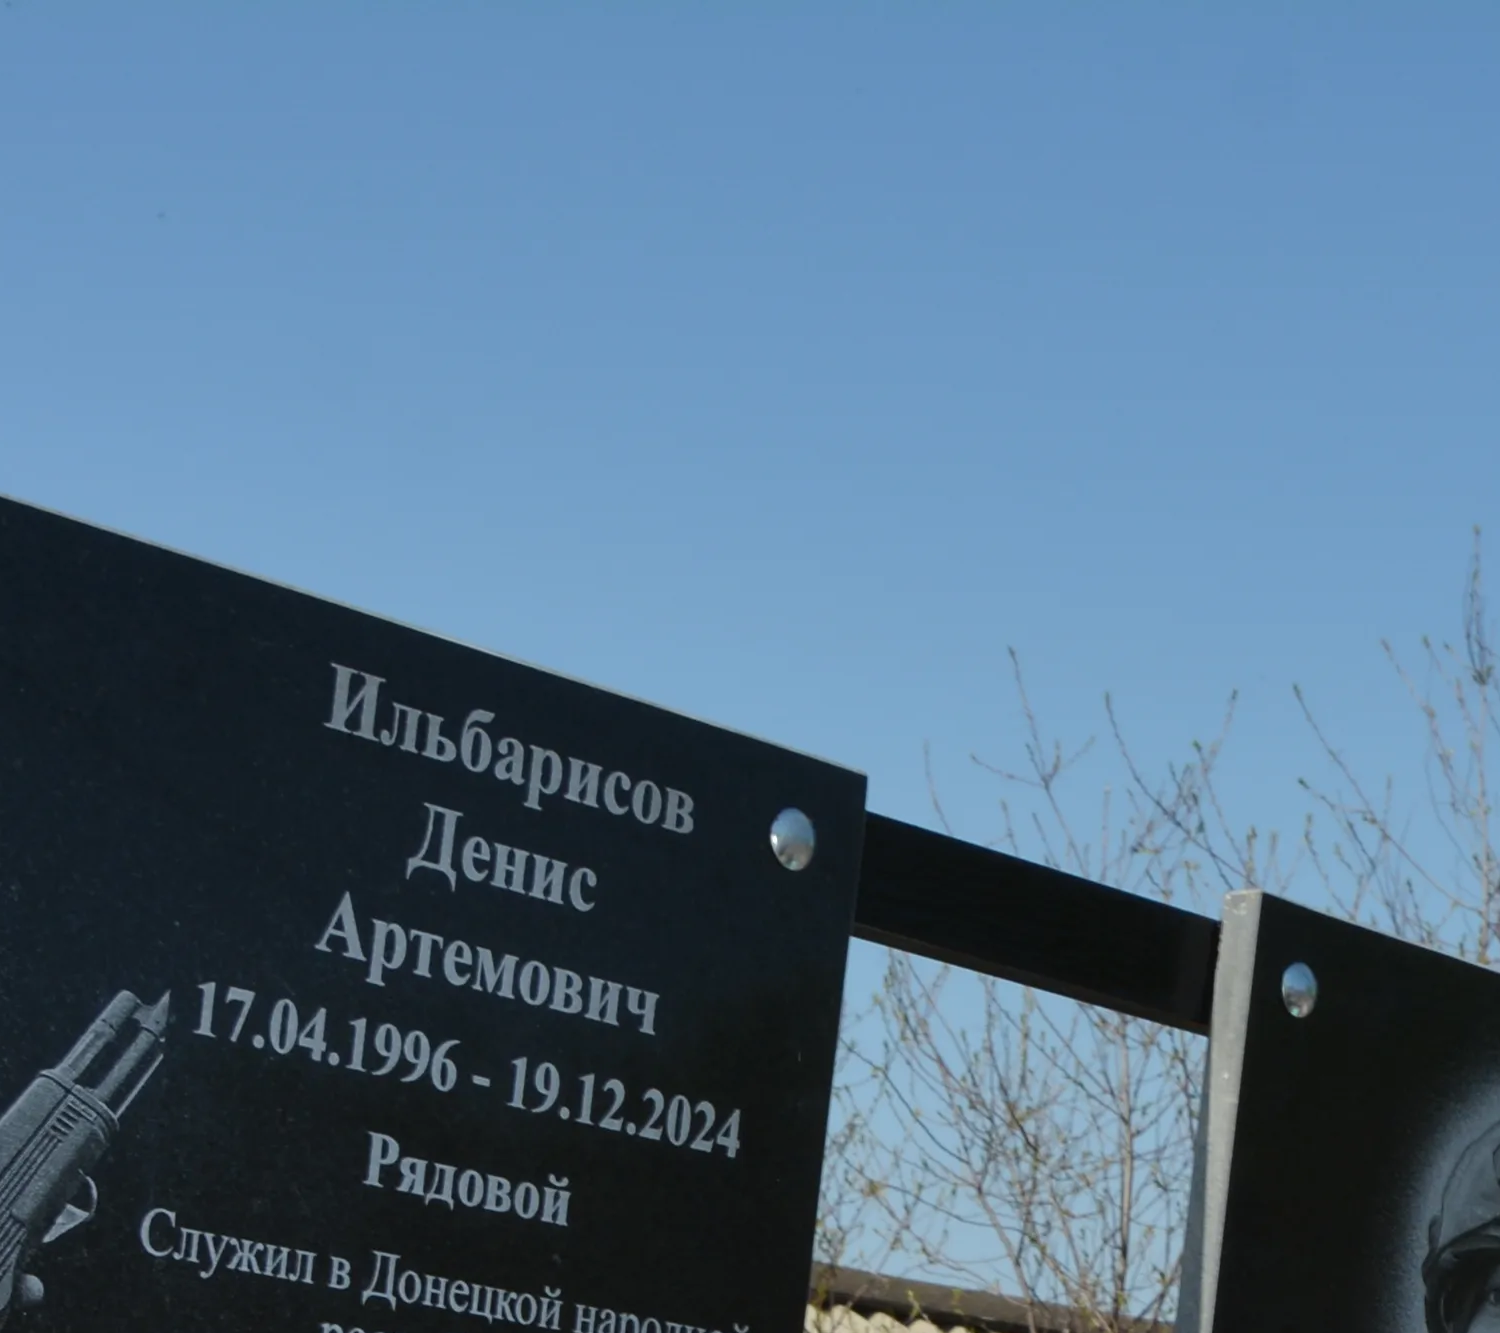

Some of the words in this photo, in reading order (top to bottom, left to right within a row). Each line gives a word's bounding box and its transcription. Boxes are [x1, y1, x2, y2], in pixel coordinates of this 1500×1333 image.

[322, 662, 695, 835] Ильбарисов
[406, 802, 598, 912] Денис
[314, 891, 660, 1036] Артемович
[191, 980, 460, 1094] 17.04.1996
[506, 1056, 743, 1160] 19.12.2024
[361, 1130, 571, 1227] Рядовой
[139, 1207, 314, 1287] Служил
[330, 1253, 351, 1290] в
[361, 1249, 563, 1333] Донецкой
